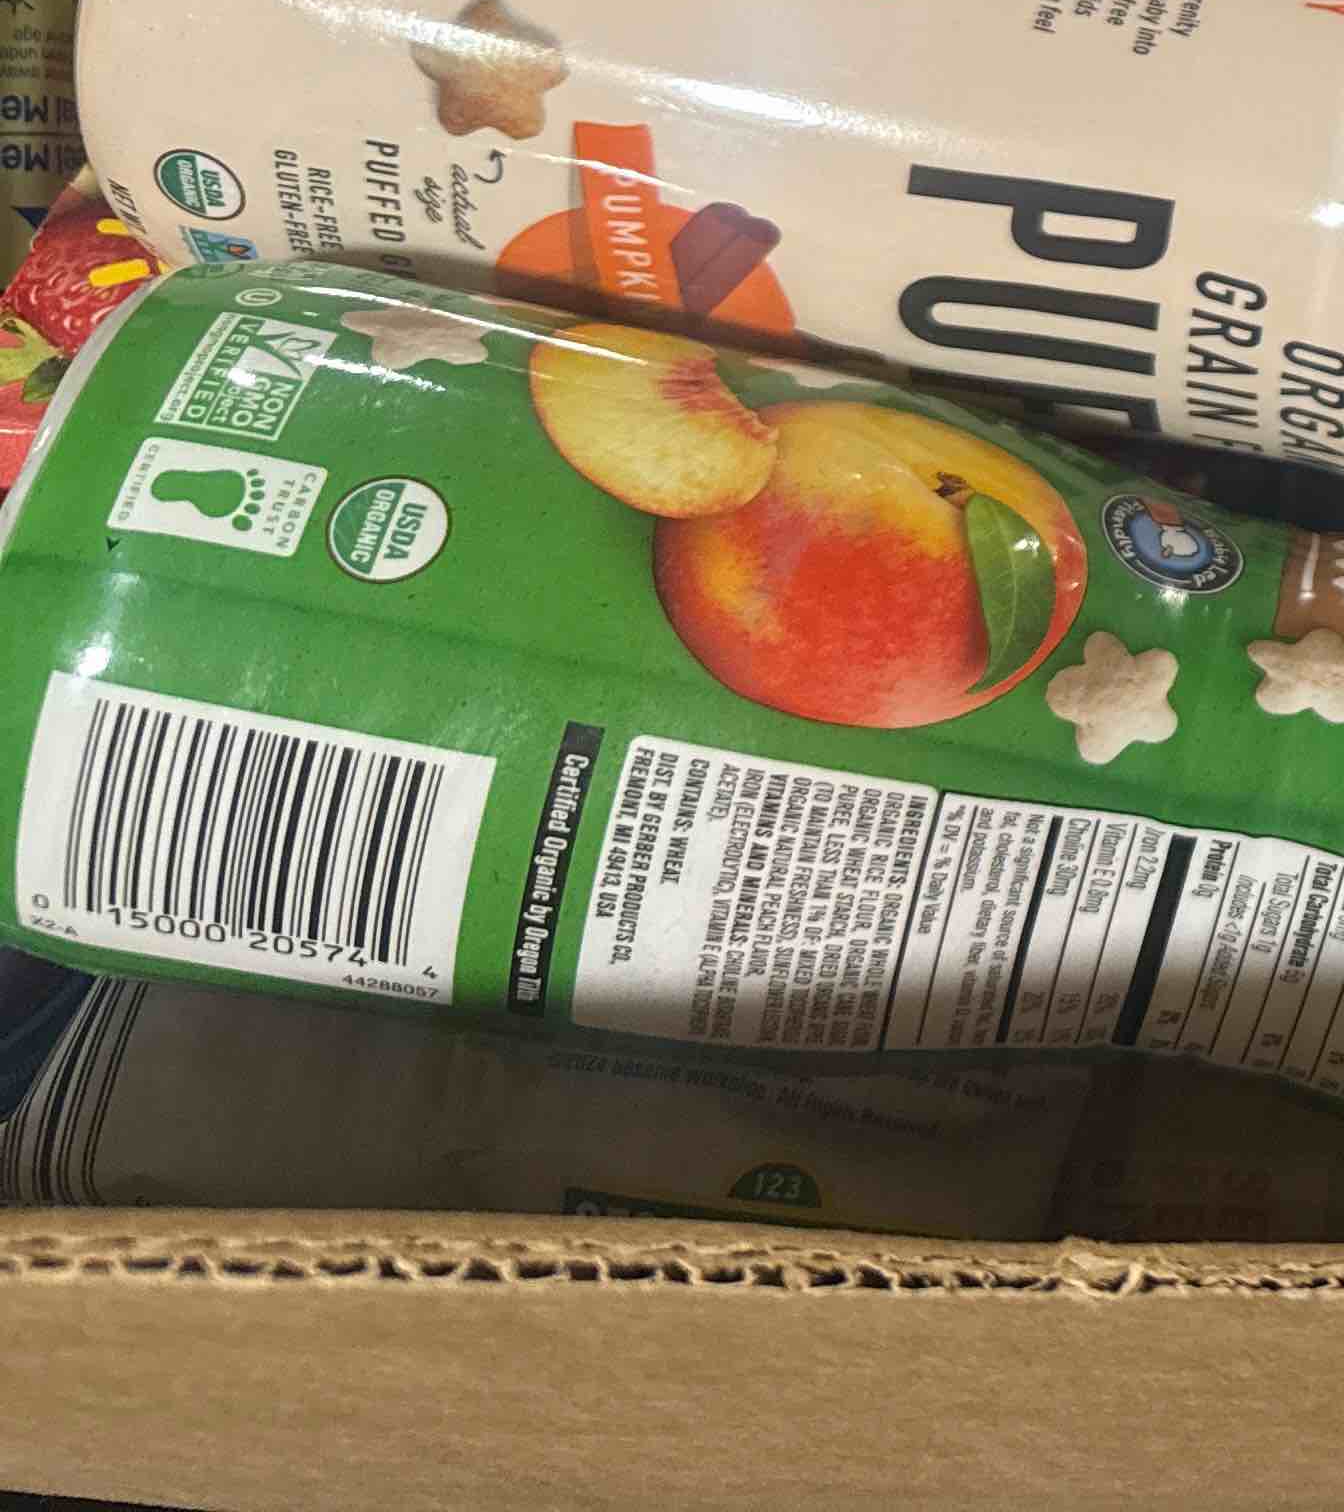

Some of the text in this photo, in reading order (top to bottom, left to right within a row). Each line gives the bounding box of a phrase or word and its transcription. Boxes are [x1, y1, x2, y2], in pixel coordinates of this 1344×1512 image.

[178, 160, 200, 207] ORGANIC
[203, 169, 225, 207] USDA
[273, 150, 313, 255] GLUTEN-FREE
[306, 168, 344, 250] RICE-FREE
[363, 141, 404, 243] PUFFED
[598, 168, 659, 301] PUMPKI
[900, 163, 1176, 435] PUF
[185, 318, 265, 419] VERIFIED
[1185, 271, 1267, 426] GRAIN
[232, 376, 273, 427] GMO
[255, 383, 294, 431] NON
[117, 444, 159, 522] CERTIFIED
[263, 480, 294, 536] TRUST
[275, 470, 316, 550] CARBON
[351, 487, 391, 563] ORGANIC
[385, 502, 428, 561] USDA
[615, 747, 653, 821] FREMONT,
[675, 758, 709, 832] CONTAINS:
[518, 755, 588, 974] Certified Organic by Oregon
[618, 752, 677, 942] DIST. BY GERBER PRODUCTS
[106, 907, 370, 967] 15000 20574
